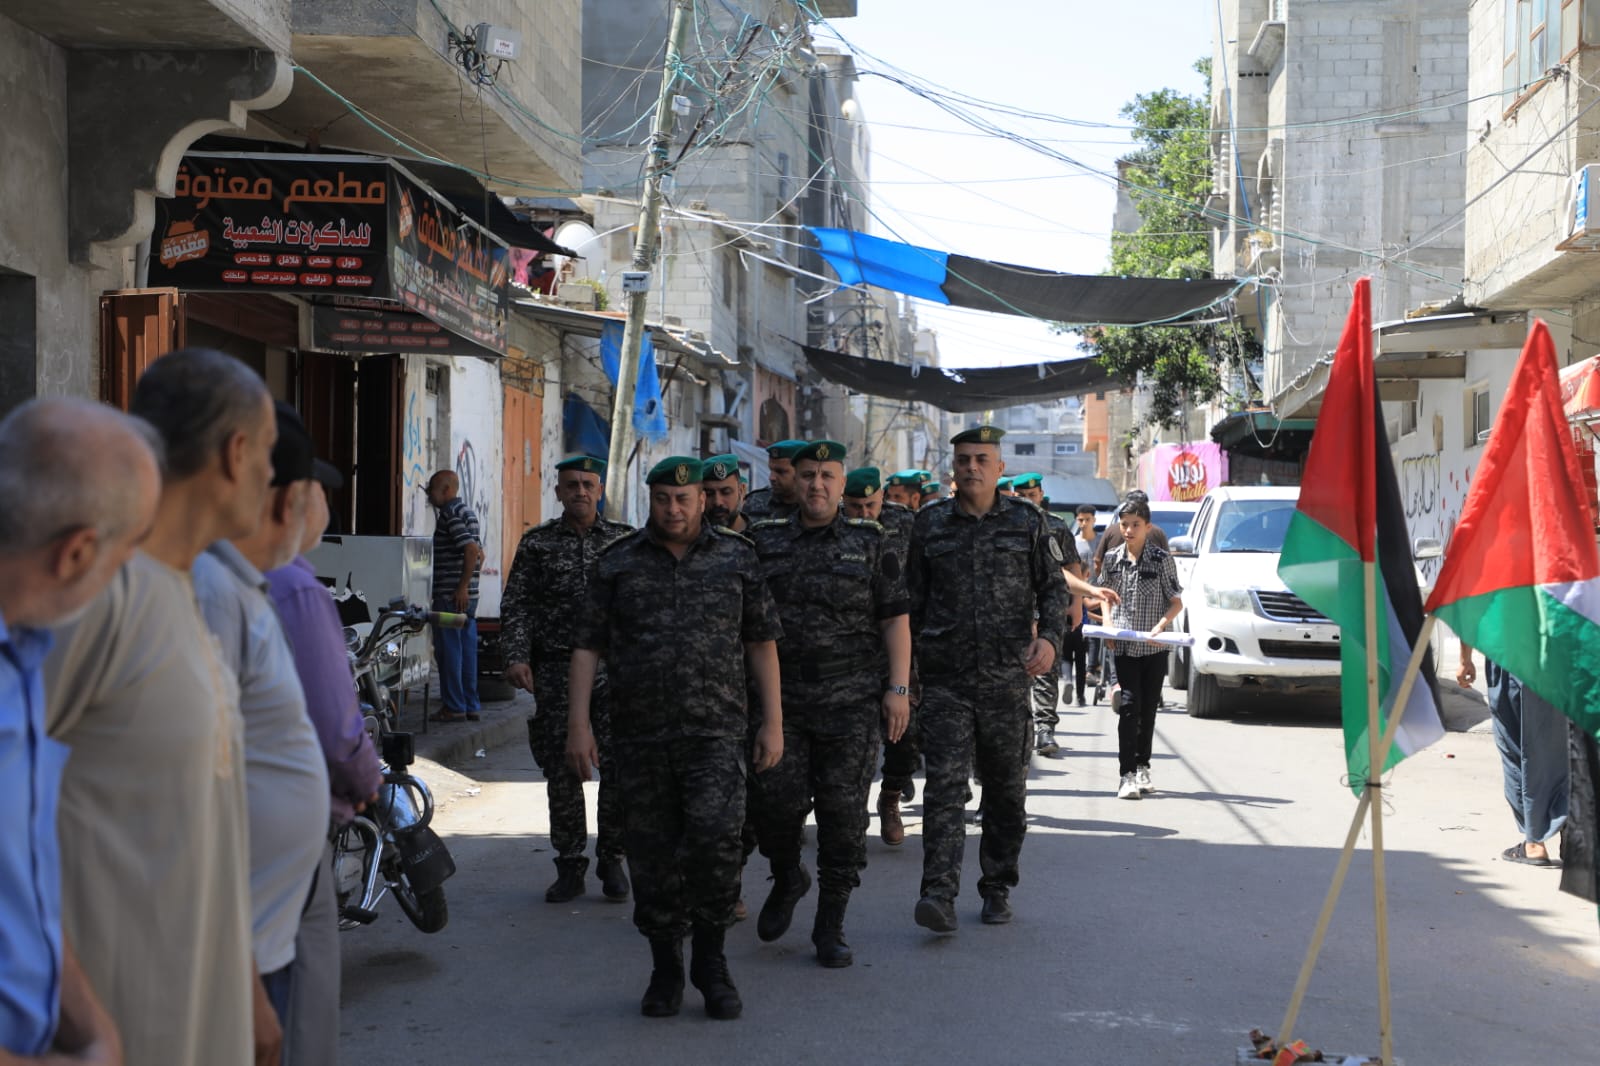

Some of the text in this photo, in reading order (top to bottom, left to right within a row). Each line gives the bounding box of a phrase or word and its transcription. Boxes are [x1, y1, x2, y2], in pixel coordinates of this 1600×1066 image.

[283, 171, 386, 213] مطعم
[222, 216, 284, 248] الشعبية
[284, 217, 371, 251] للمأكولات
[235, 256, 256, 265] حمص
[278, 255, 300, 266] فلافل
[308, 257, 331, 265] حمص
[341, 259, 356, 268] فول
[224, 272, 246, 281] سلطات
